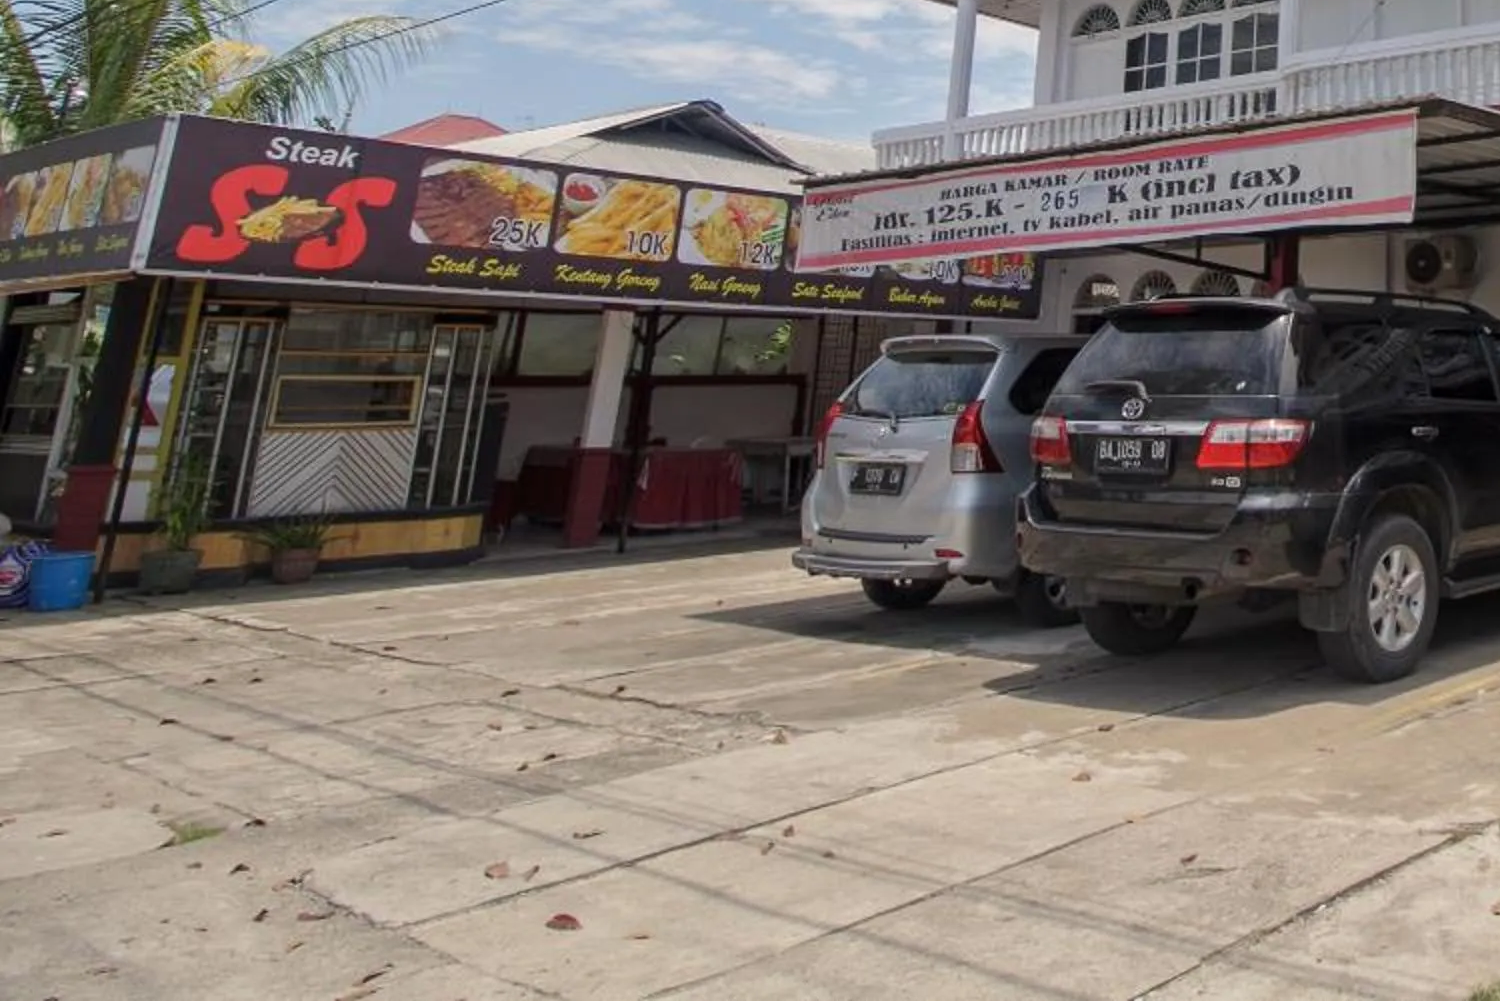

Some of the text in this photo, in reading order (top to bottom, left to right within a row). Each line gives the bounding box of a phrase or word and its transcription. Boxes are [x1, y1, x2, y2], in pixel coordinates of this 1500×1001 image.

[265, 136, 359, 168] Steak
[941, 182, 998, 201] HARGA
[1005, 174, 1067, 192] KAMAR
[1094, 163, 1150, 181] ROOM
[1158, 155, 1209, 173] RATE
[1041, 189, 1080, 212] 265
[1128, 204, 1162, 221] air
[490, 216, 544, 247] 25K
[627, 230, 668, 255] 10K
[426, 255, 477, 274] Steak
[739, 242, 775, 264] 12K
